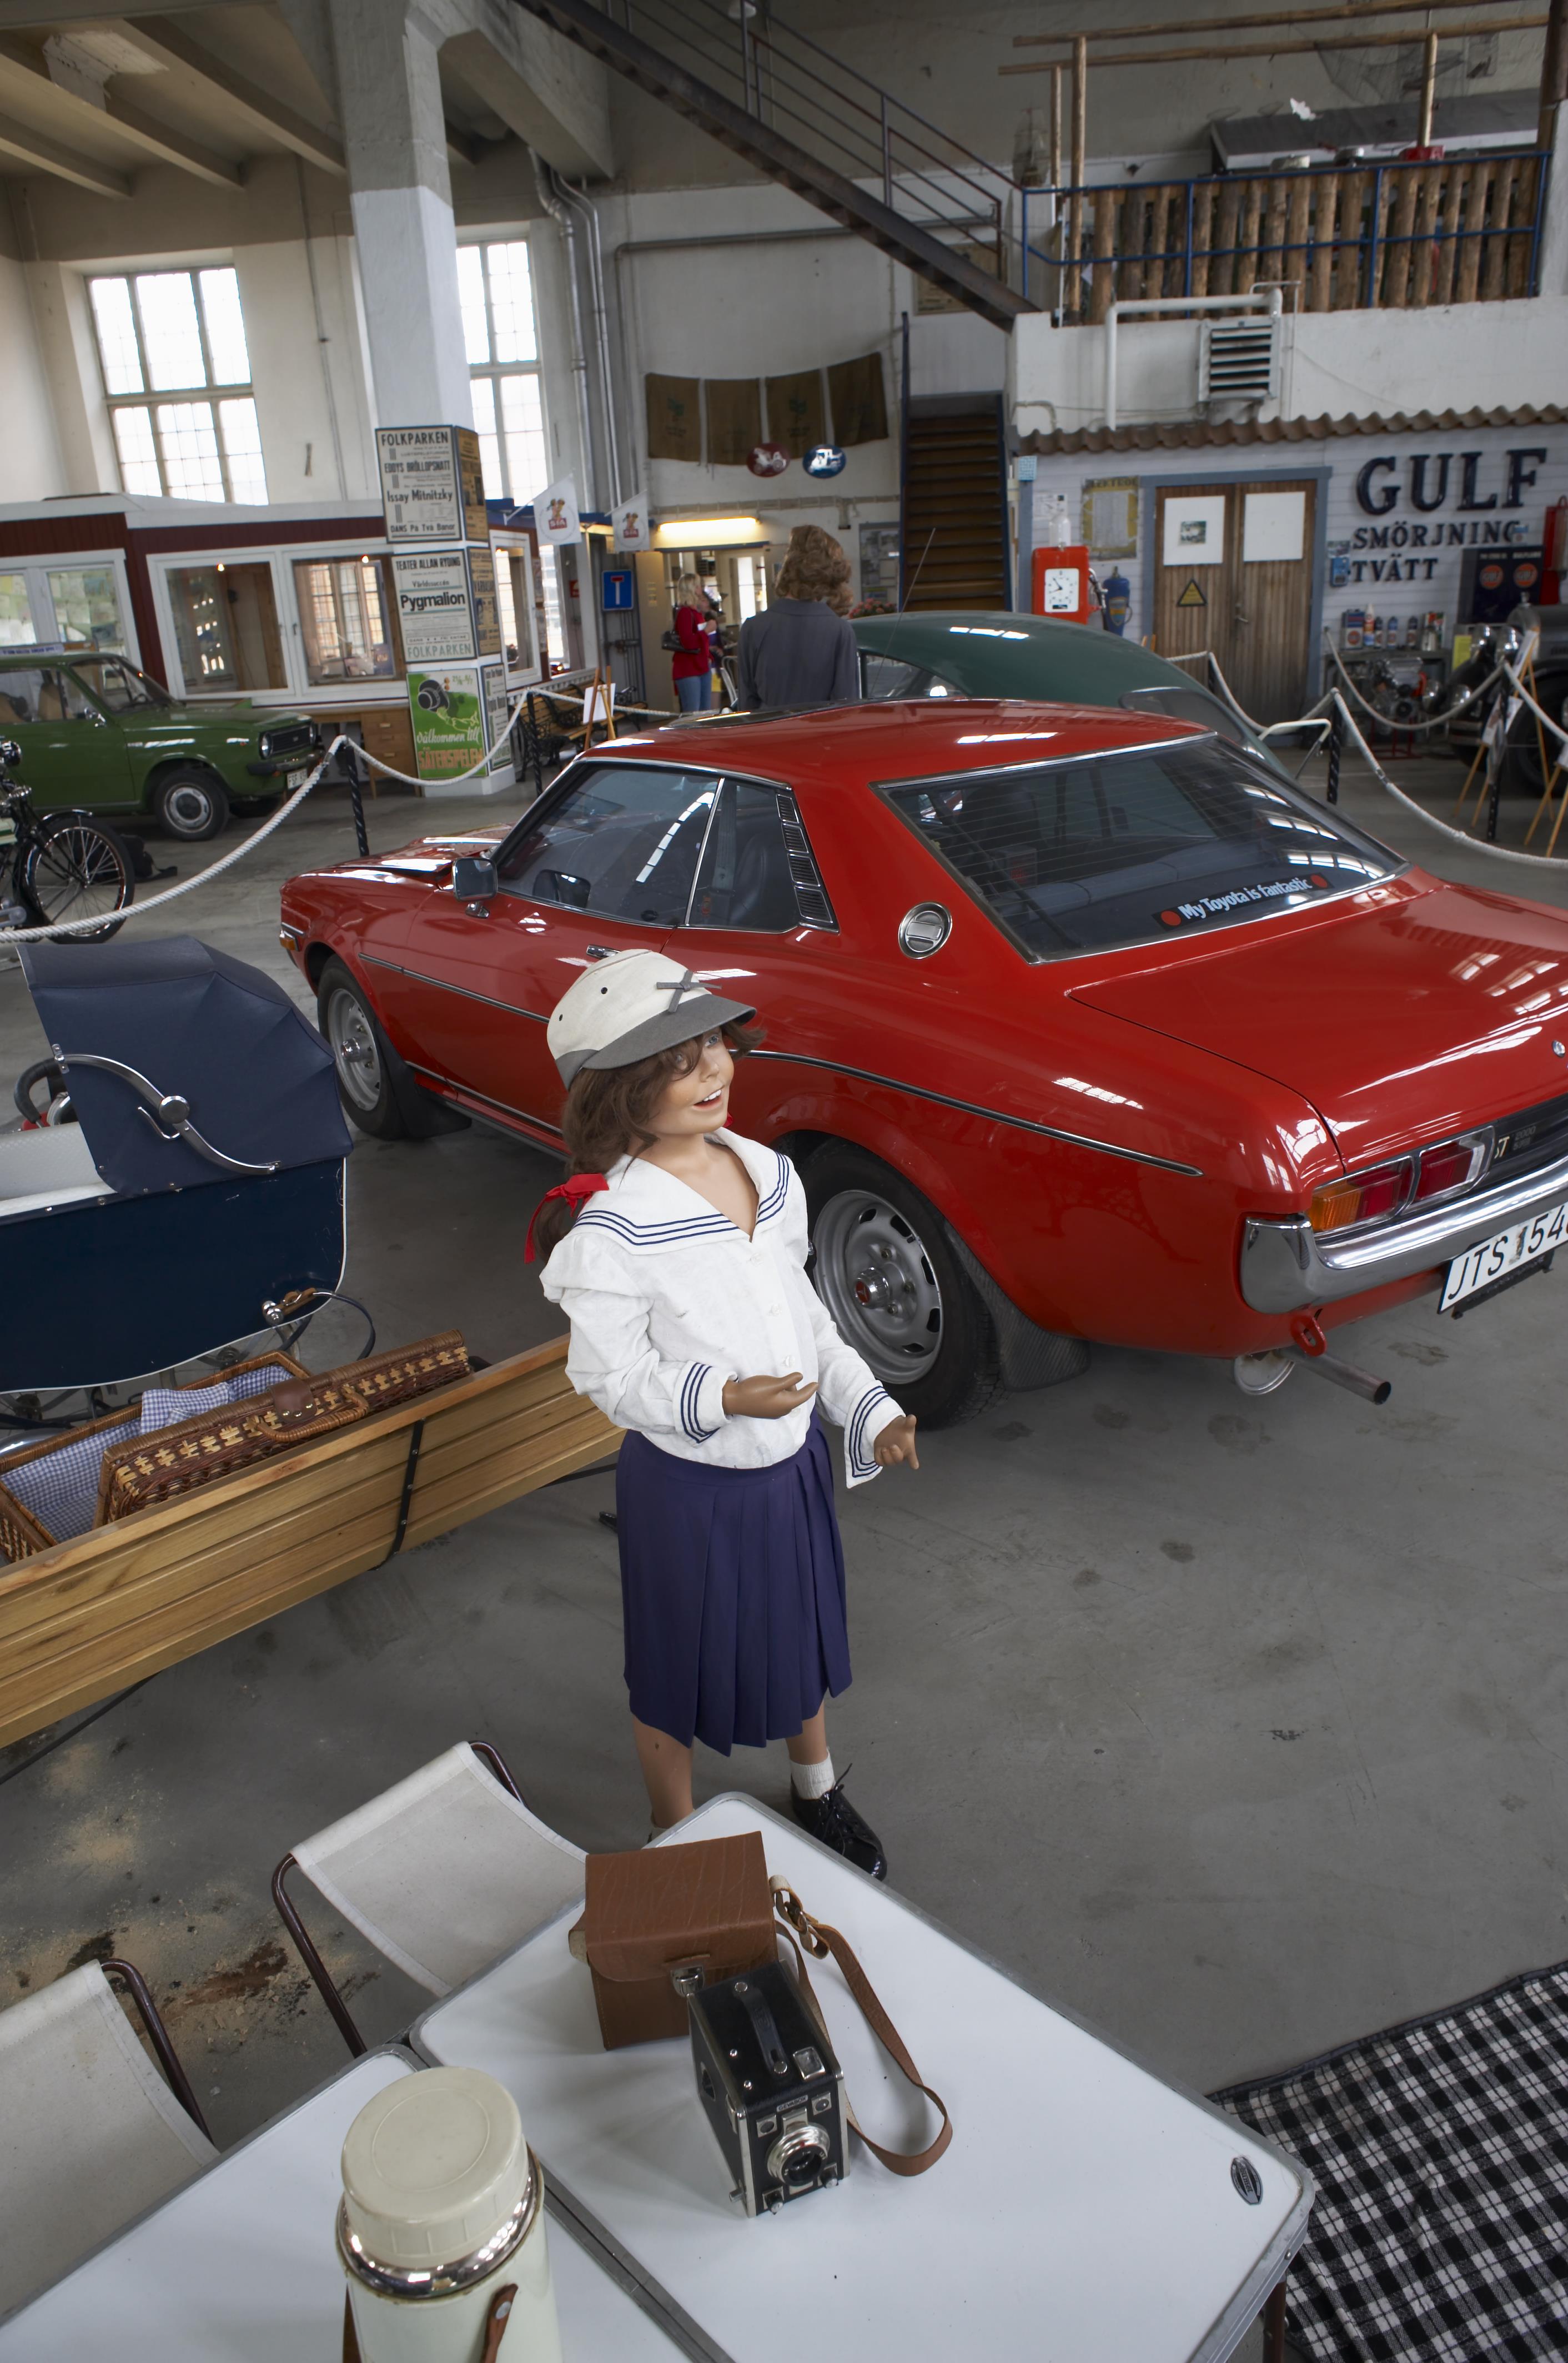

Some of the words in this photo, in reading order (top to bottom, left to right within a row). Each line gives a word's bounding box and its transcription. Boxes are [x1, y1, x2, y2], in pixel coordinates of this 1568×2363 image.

[381, 432, 448, 445] FOLKPARKEN
[1356, 448, 1547, 515] GULF
[387, 491, 409, 504] Issay
[396, 559, 417, 571] TEATER
[419, 558, 438, 569] ALLAN
[1352, 554, 1438, 582] TVÄTT
[400, 592, 465, 612] Pygmalion
[408, 643, 471, 658] FOLKPARKEN
[1178, 904, 1207, 919] My
[1199, 893, 1250, 911] Toyota
[1243, 888, 1262, 901] is
[1258, 877, 1313, 898] fantastic
[1448, 1235, 1509, 1300] JTS
[1528, 1205, 1568, 1254] 54
